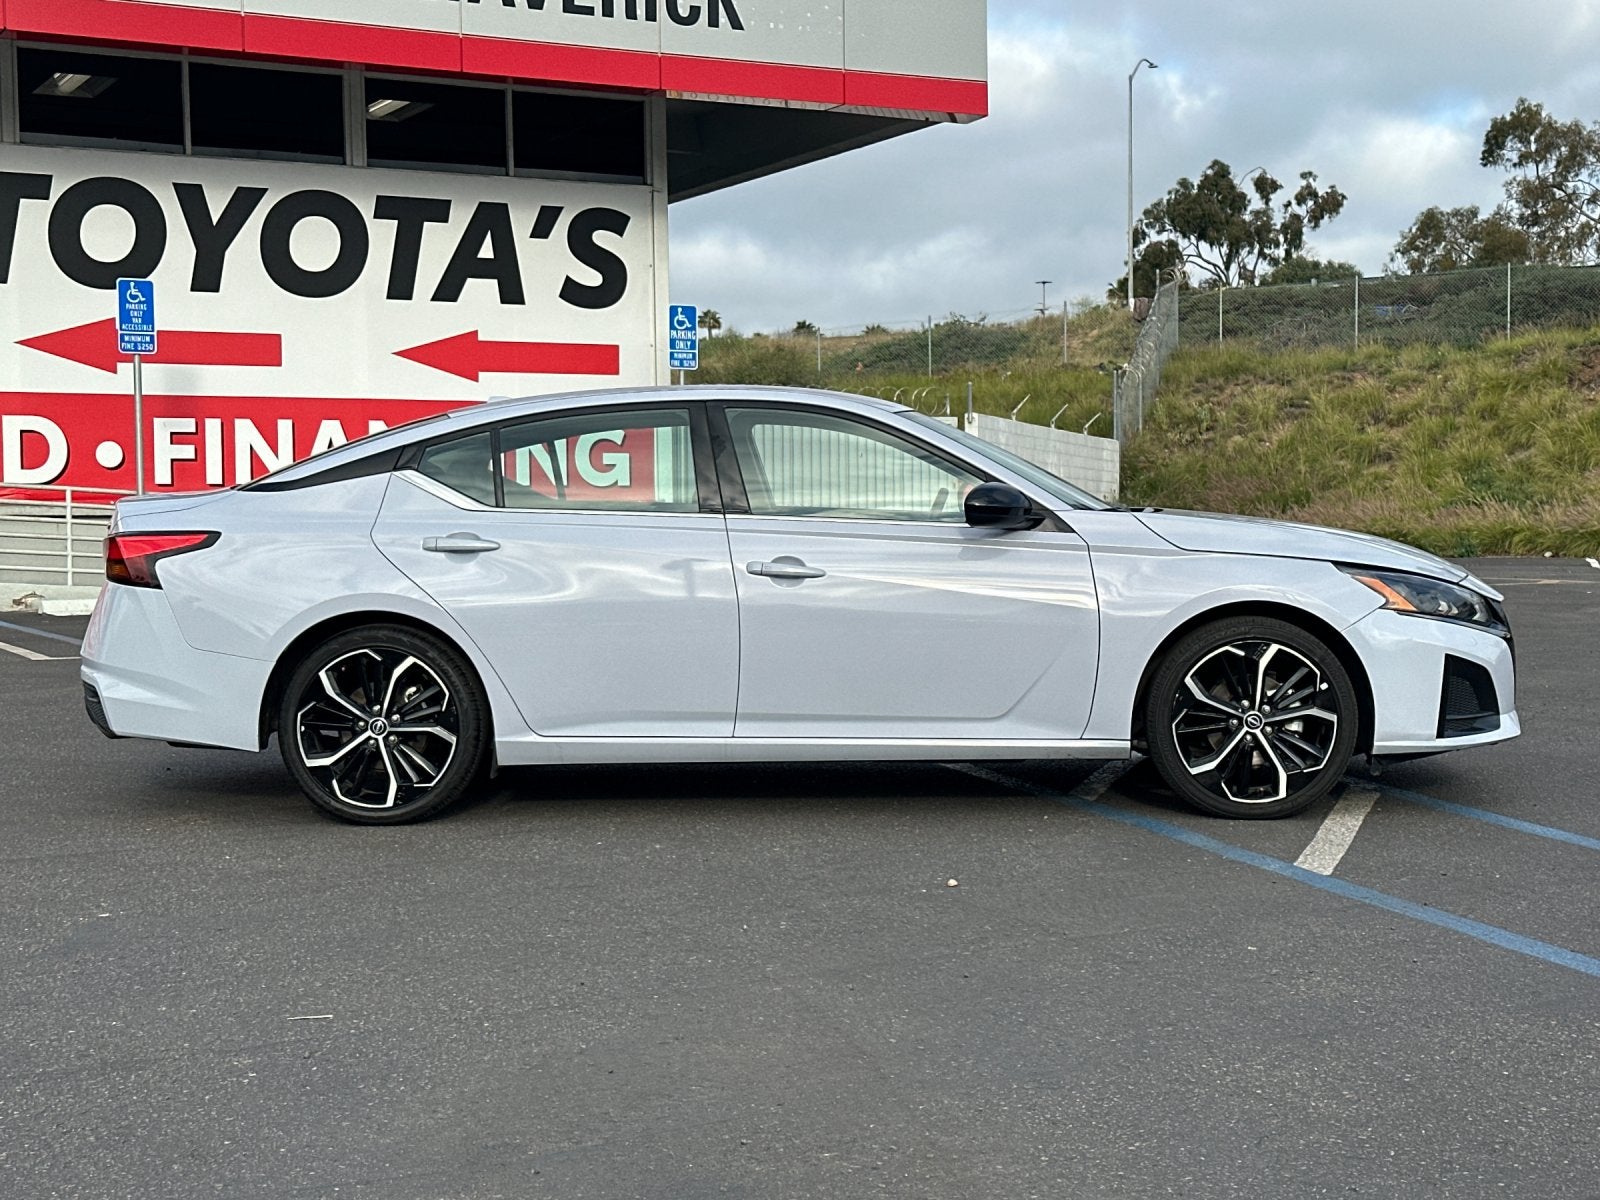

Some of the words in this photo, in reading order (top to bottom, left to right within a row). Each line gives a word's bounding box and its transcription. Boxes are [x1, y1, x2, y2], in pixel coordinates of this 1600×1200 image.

[126, 303, 147, 311] PARKING
[121, 323, 153, 331] ACCESSIBLE
[124, 335, 151, 343] MINIMUM
[670, 330, 696, 340] PARKING
[121, 342, 135, 350] FINE
[675, 340, 691, 349] ONLY
